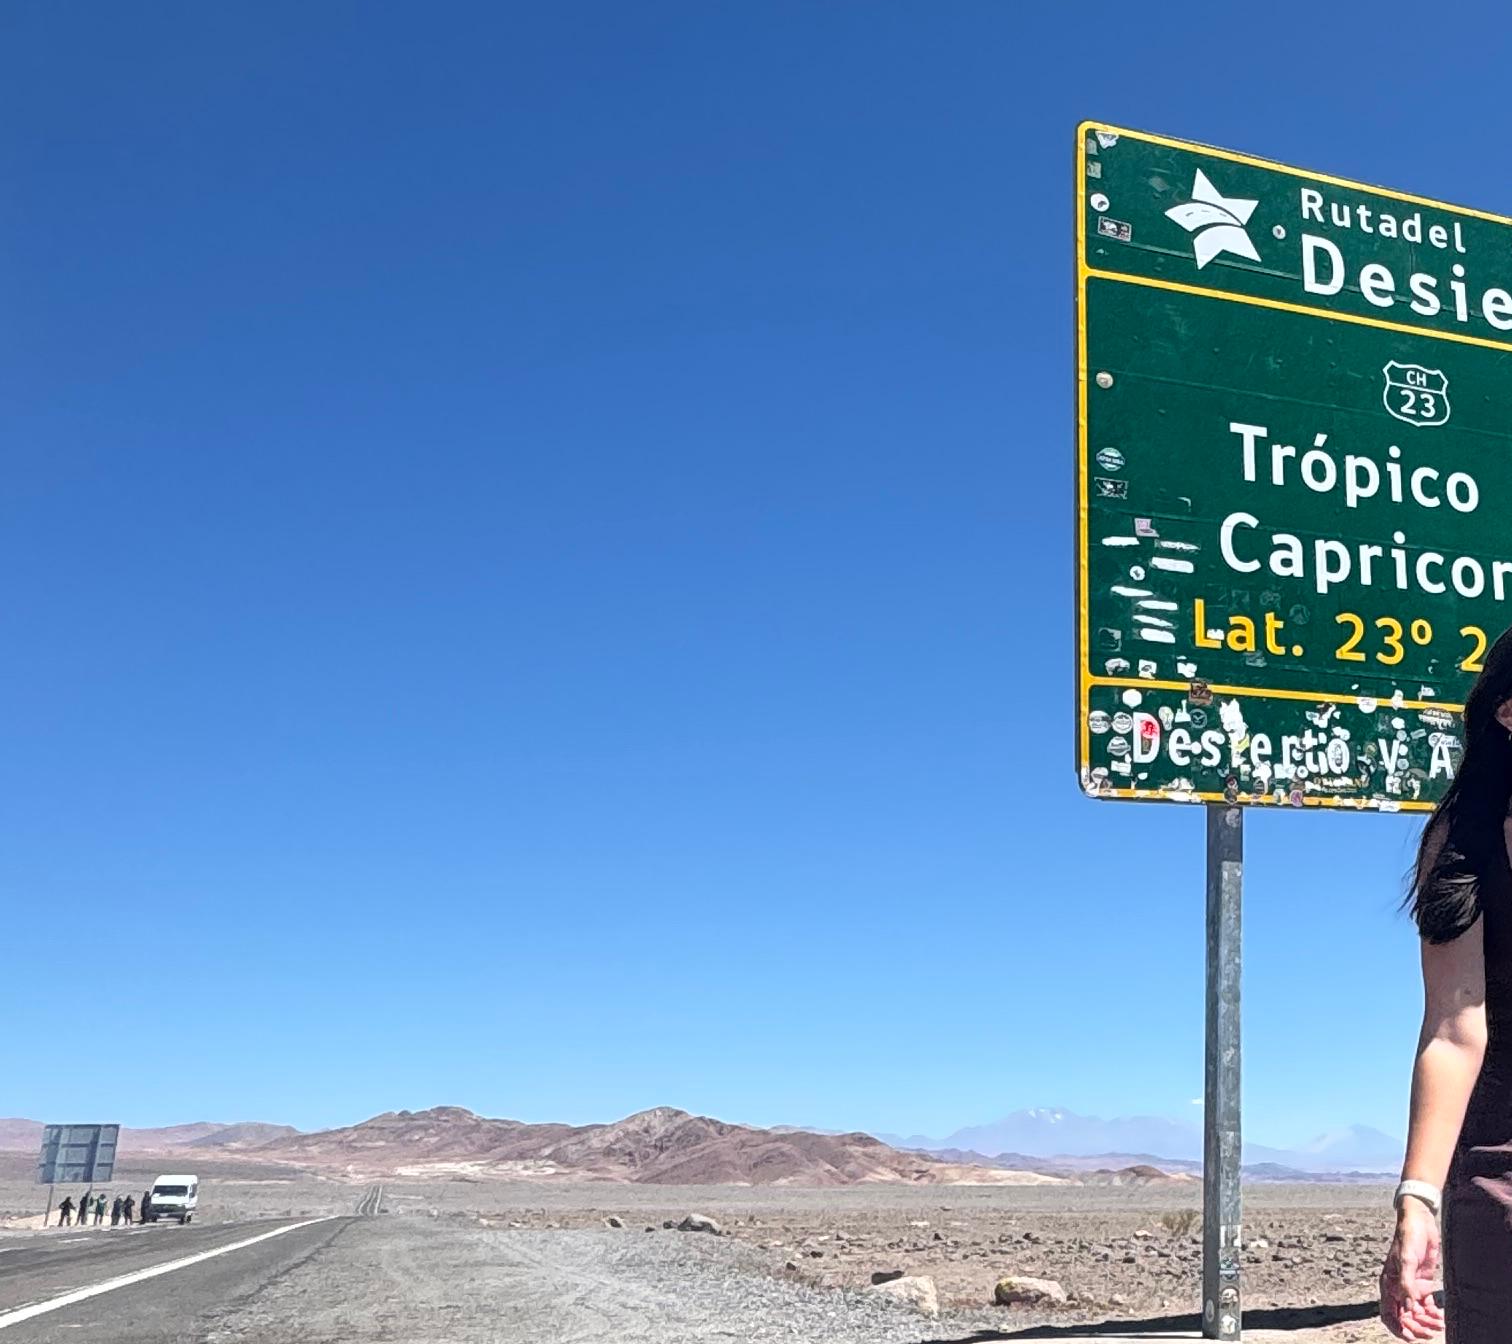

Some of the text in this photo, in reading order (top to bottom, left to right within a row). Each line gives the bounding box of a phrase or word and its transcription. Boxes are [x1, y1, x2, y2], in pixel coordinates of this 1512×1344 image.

[1406, 370, 1427, 387] CH
[1400, 389, 1436, 418] 23
[1229, 421, 1480, 514] Trópico
[1194, 597, 1304, 657] Lat.
